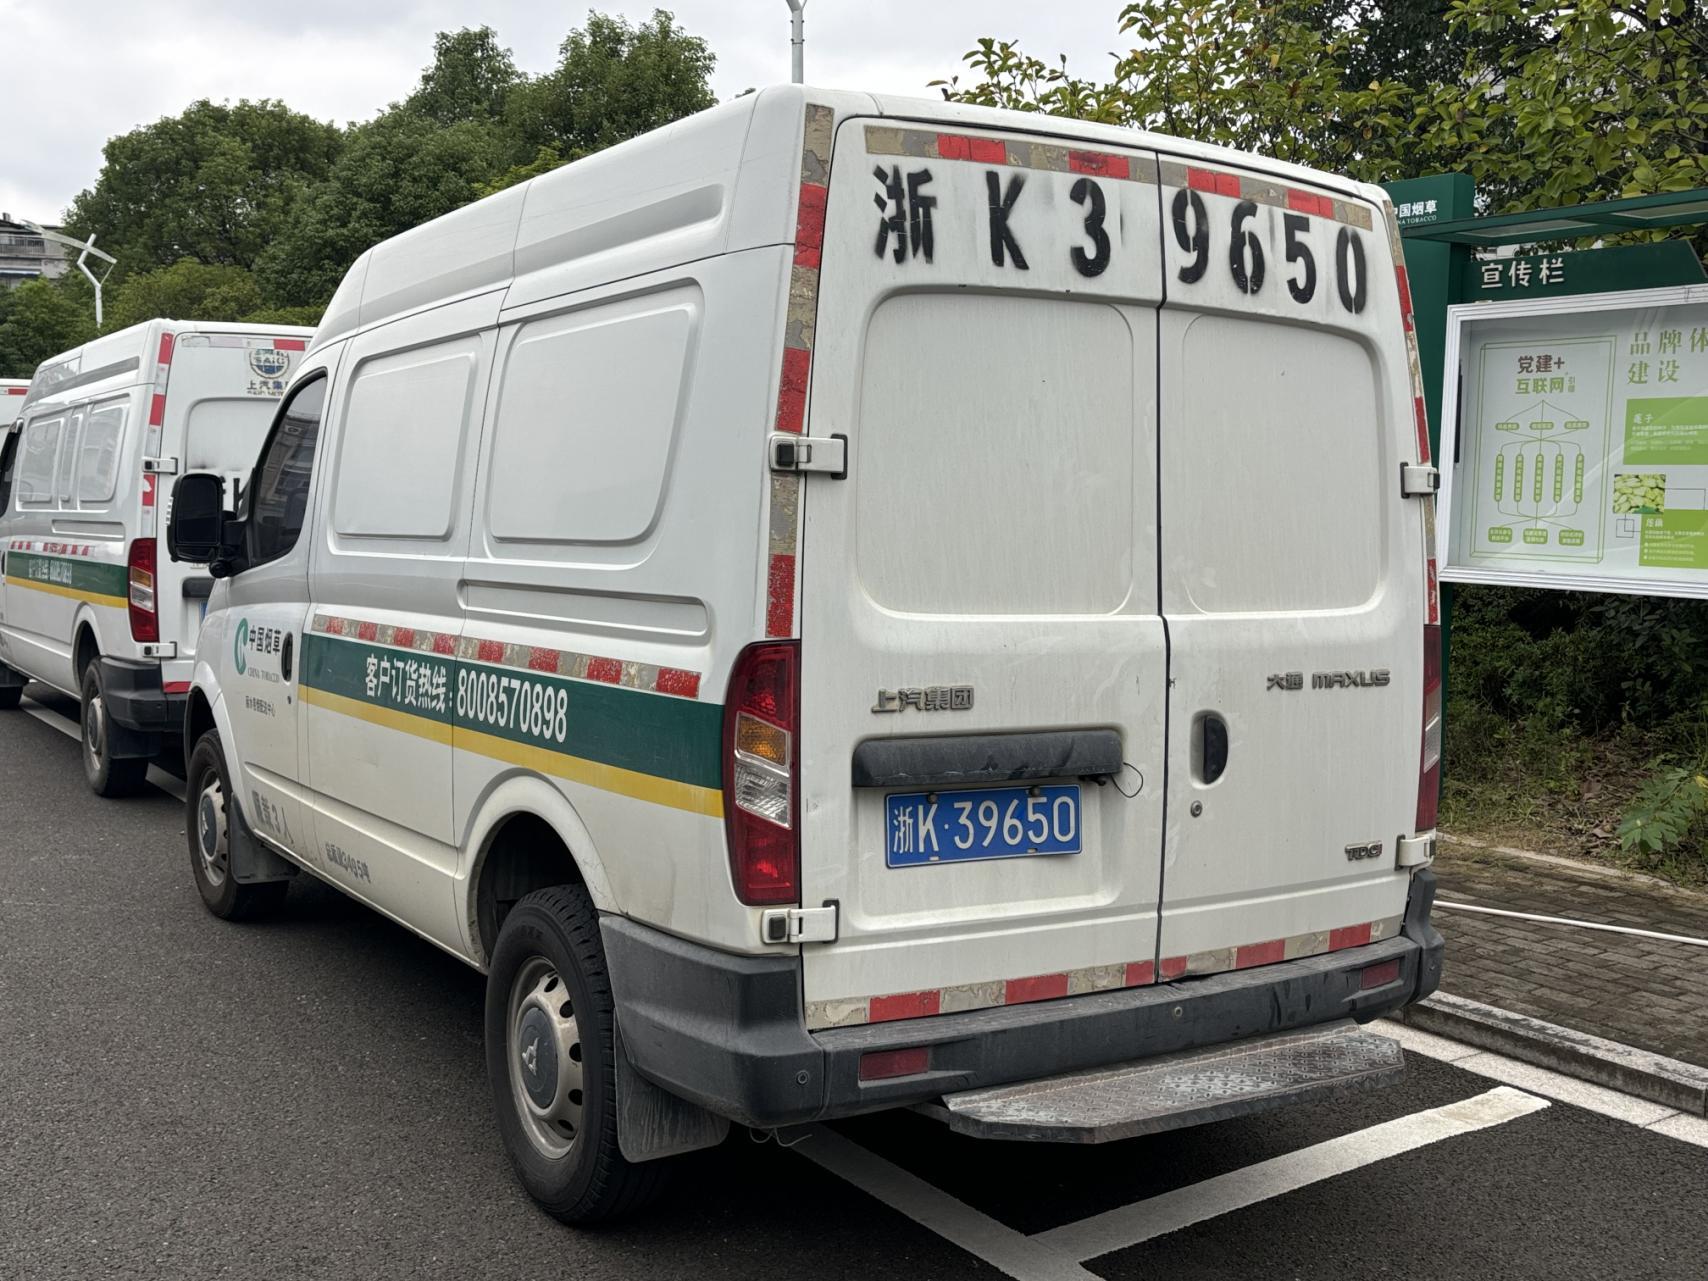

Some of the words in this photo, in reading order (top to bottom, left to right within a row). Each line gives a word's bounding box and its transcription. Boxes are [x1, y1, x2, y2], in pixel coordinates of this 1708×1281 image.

[1481, 257, 1565, 289] 宣传栏
[1517, 354, 1565, 374] 党建+
[1628, 359, 1680, 385] 建设
[1515, 377, 1564, 395] 互联网
[249, 625, 281, 656] 中国烟草
[1266, 672, 1304, 691] 大通
[1312, 669, 1391, 690] MAXUS
[871, 684, 974, 713] 上汽集团
